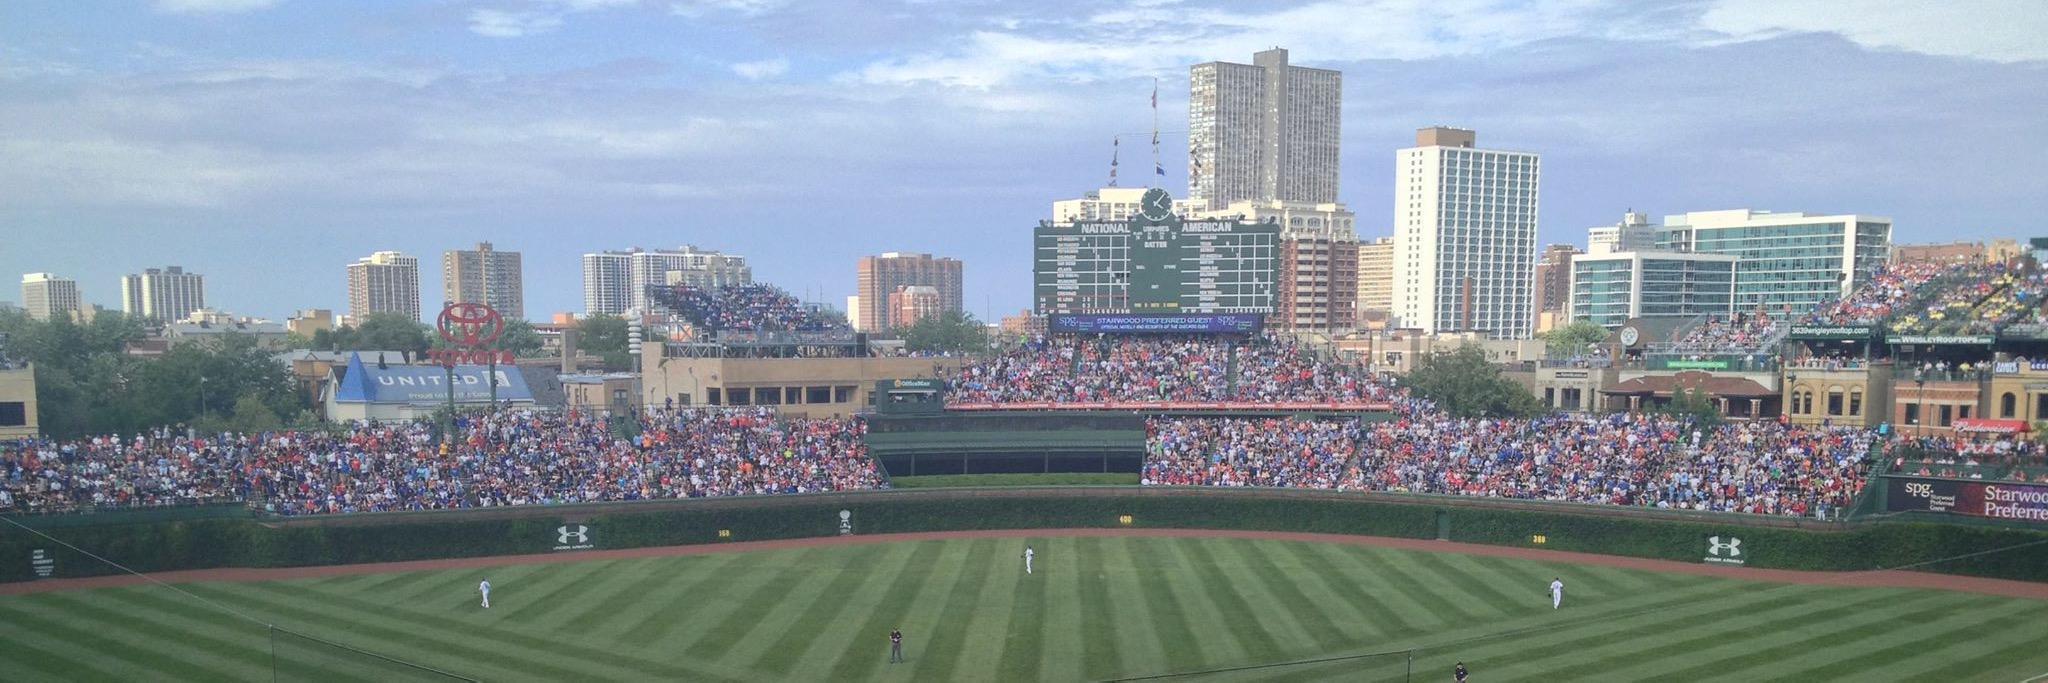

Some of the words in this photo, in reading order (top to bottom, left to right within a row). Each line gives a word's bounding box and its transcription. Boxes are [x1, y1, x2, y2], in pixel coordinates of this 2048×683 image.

[1082, 223, 1130, 234] NATIONAL
[1182, 222, 1232, 232] AMERICAN
[425, 349, 516, 367] TOYOTA
[378, 375, 478, 386] UNITED
[1905, 482, 1934, 497] spg.
[1985, 485, 2048, 503] Starwoo
[1984, 502, 2048, 520] Preferre
[1120, 515, 1132, 523] 400
